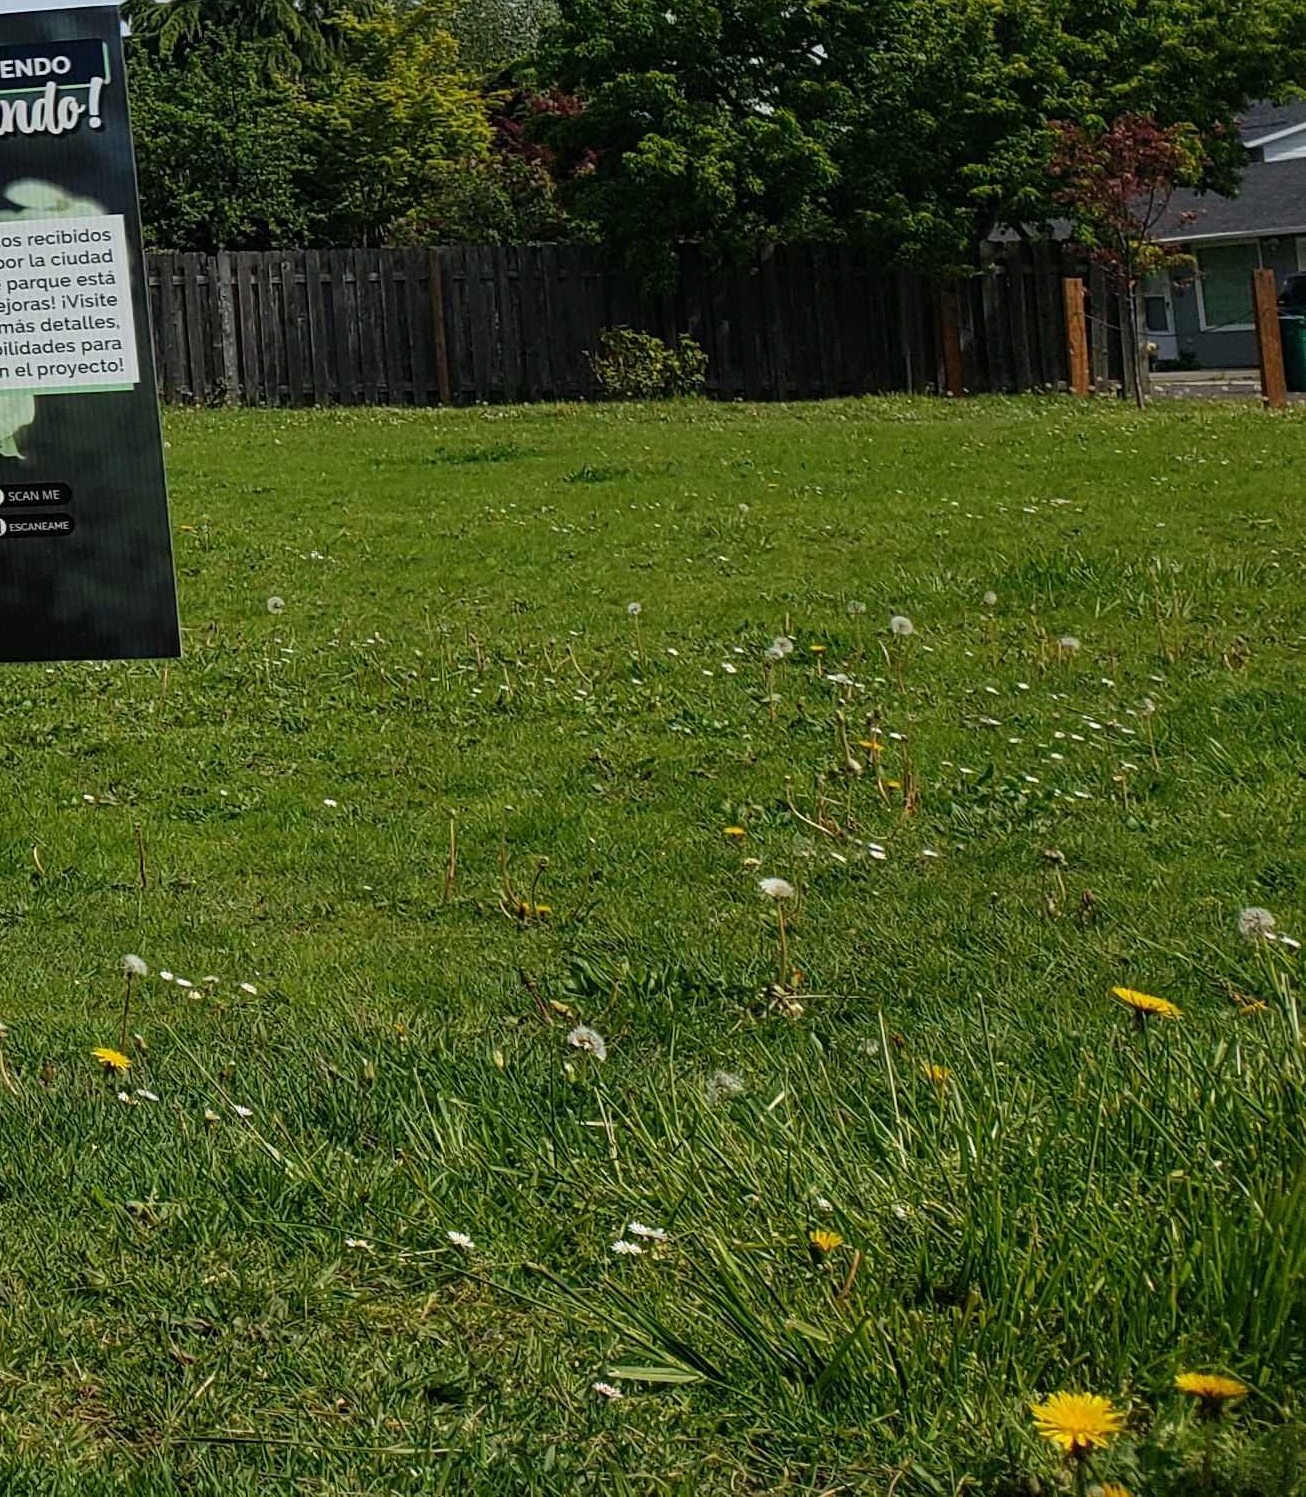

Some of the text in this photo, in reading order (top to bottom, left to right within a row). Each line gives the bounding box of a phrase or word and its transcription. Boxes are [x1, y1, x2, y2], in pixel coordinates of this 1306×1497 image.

[27, 228, 112, 246] recibidos
[28, 253, 46, 268] la
[50, 248, 114, 267] ciudad
[6, 276, 71, 295] parque
[76, 270, 116, 287] está
[61, 293, 118, 309] ¡Visite
[40, 315, 120, 332] detalles,
[81, 339, 122, 356] para
[14, 362, 33, 377] el
[37, 357, 124, 380] proyecto!
[8, 489, 61, 502] SCAN ME
